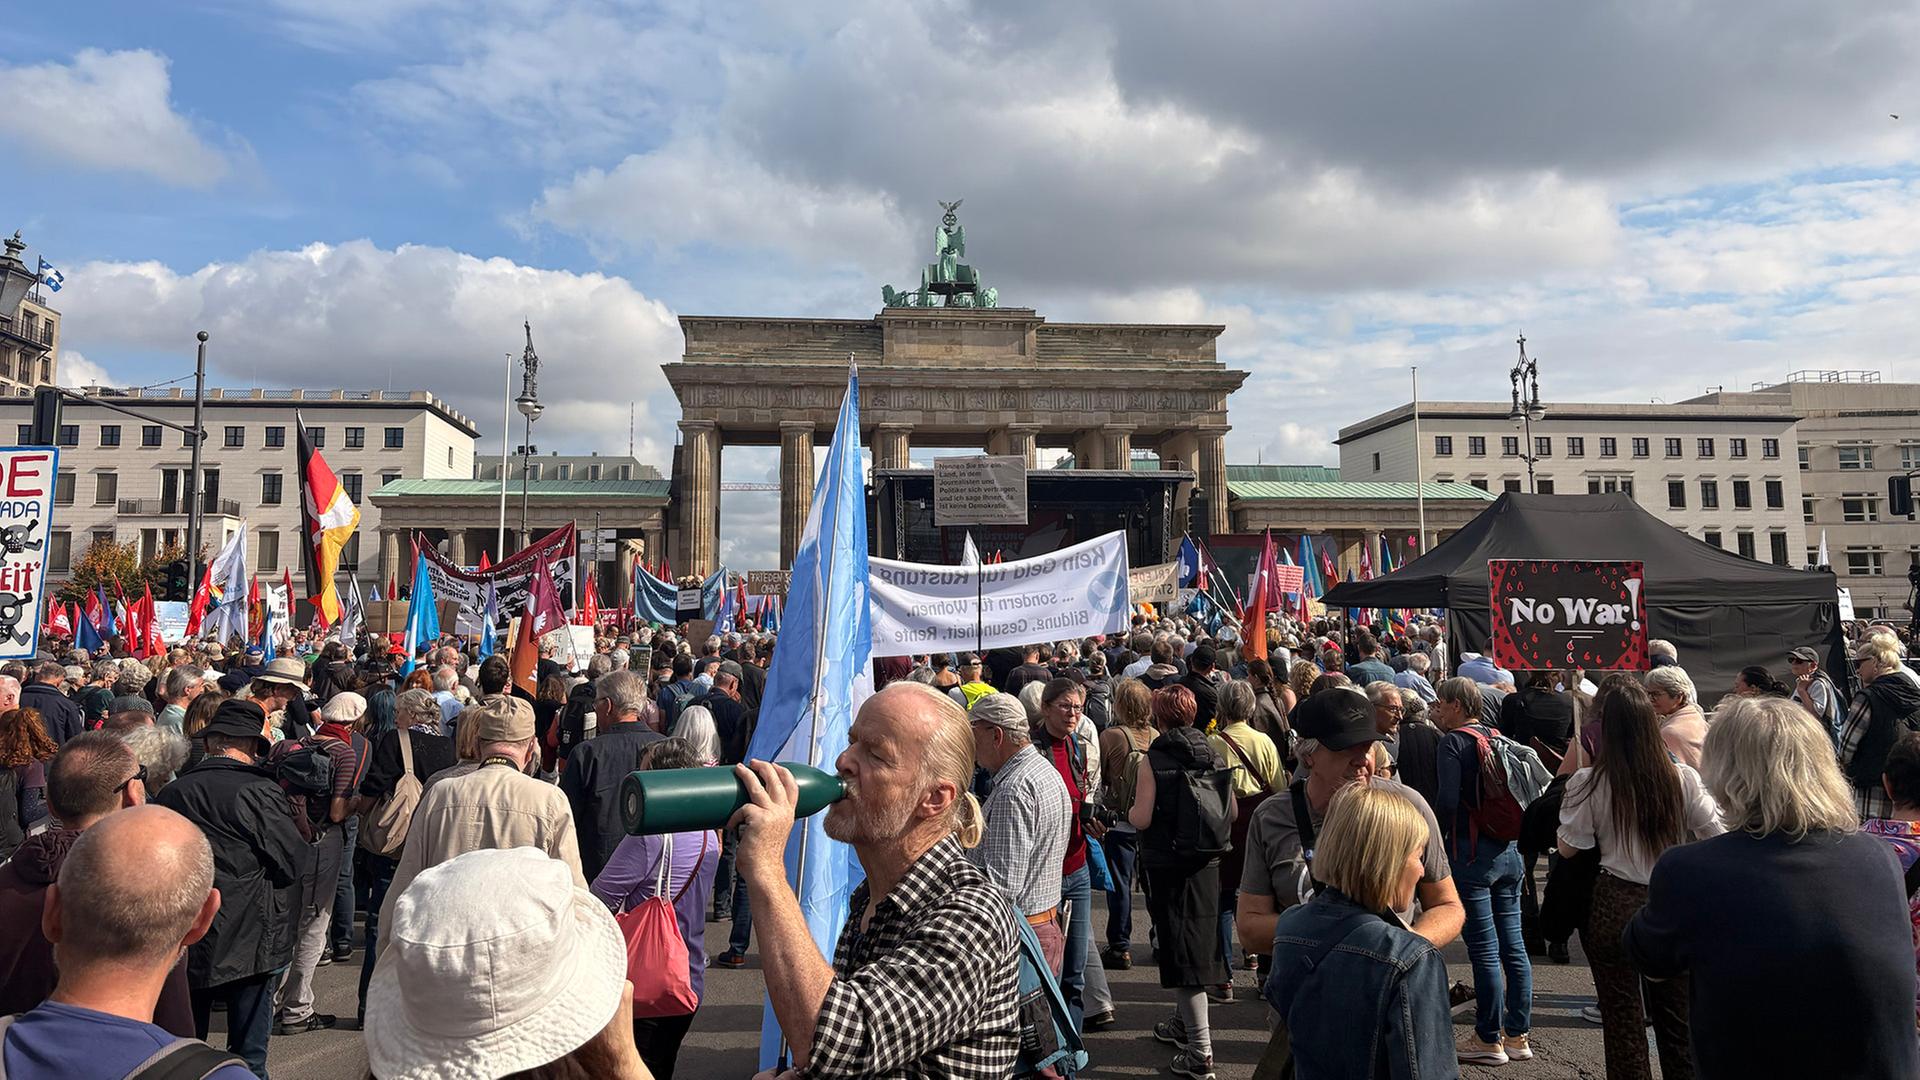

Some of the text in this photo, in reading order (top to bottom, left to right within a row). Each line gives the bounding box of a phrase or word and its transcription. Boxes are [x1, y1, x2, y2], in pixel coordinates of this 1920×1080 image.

[0, 455, 48, 497] E
[0, 500, 40, 518] ADA
[1509, 578, 1641, 631] No War!
